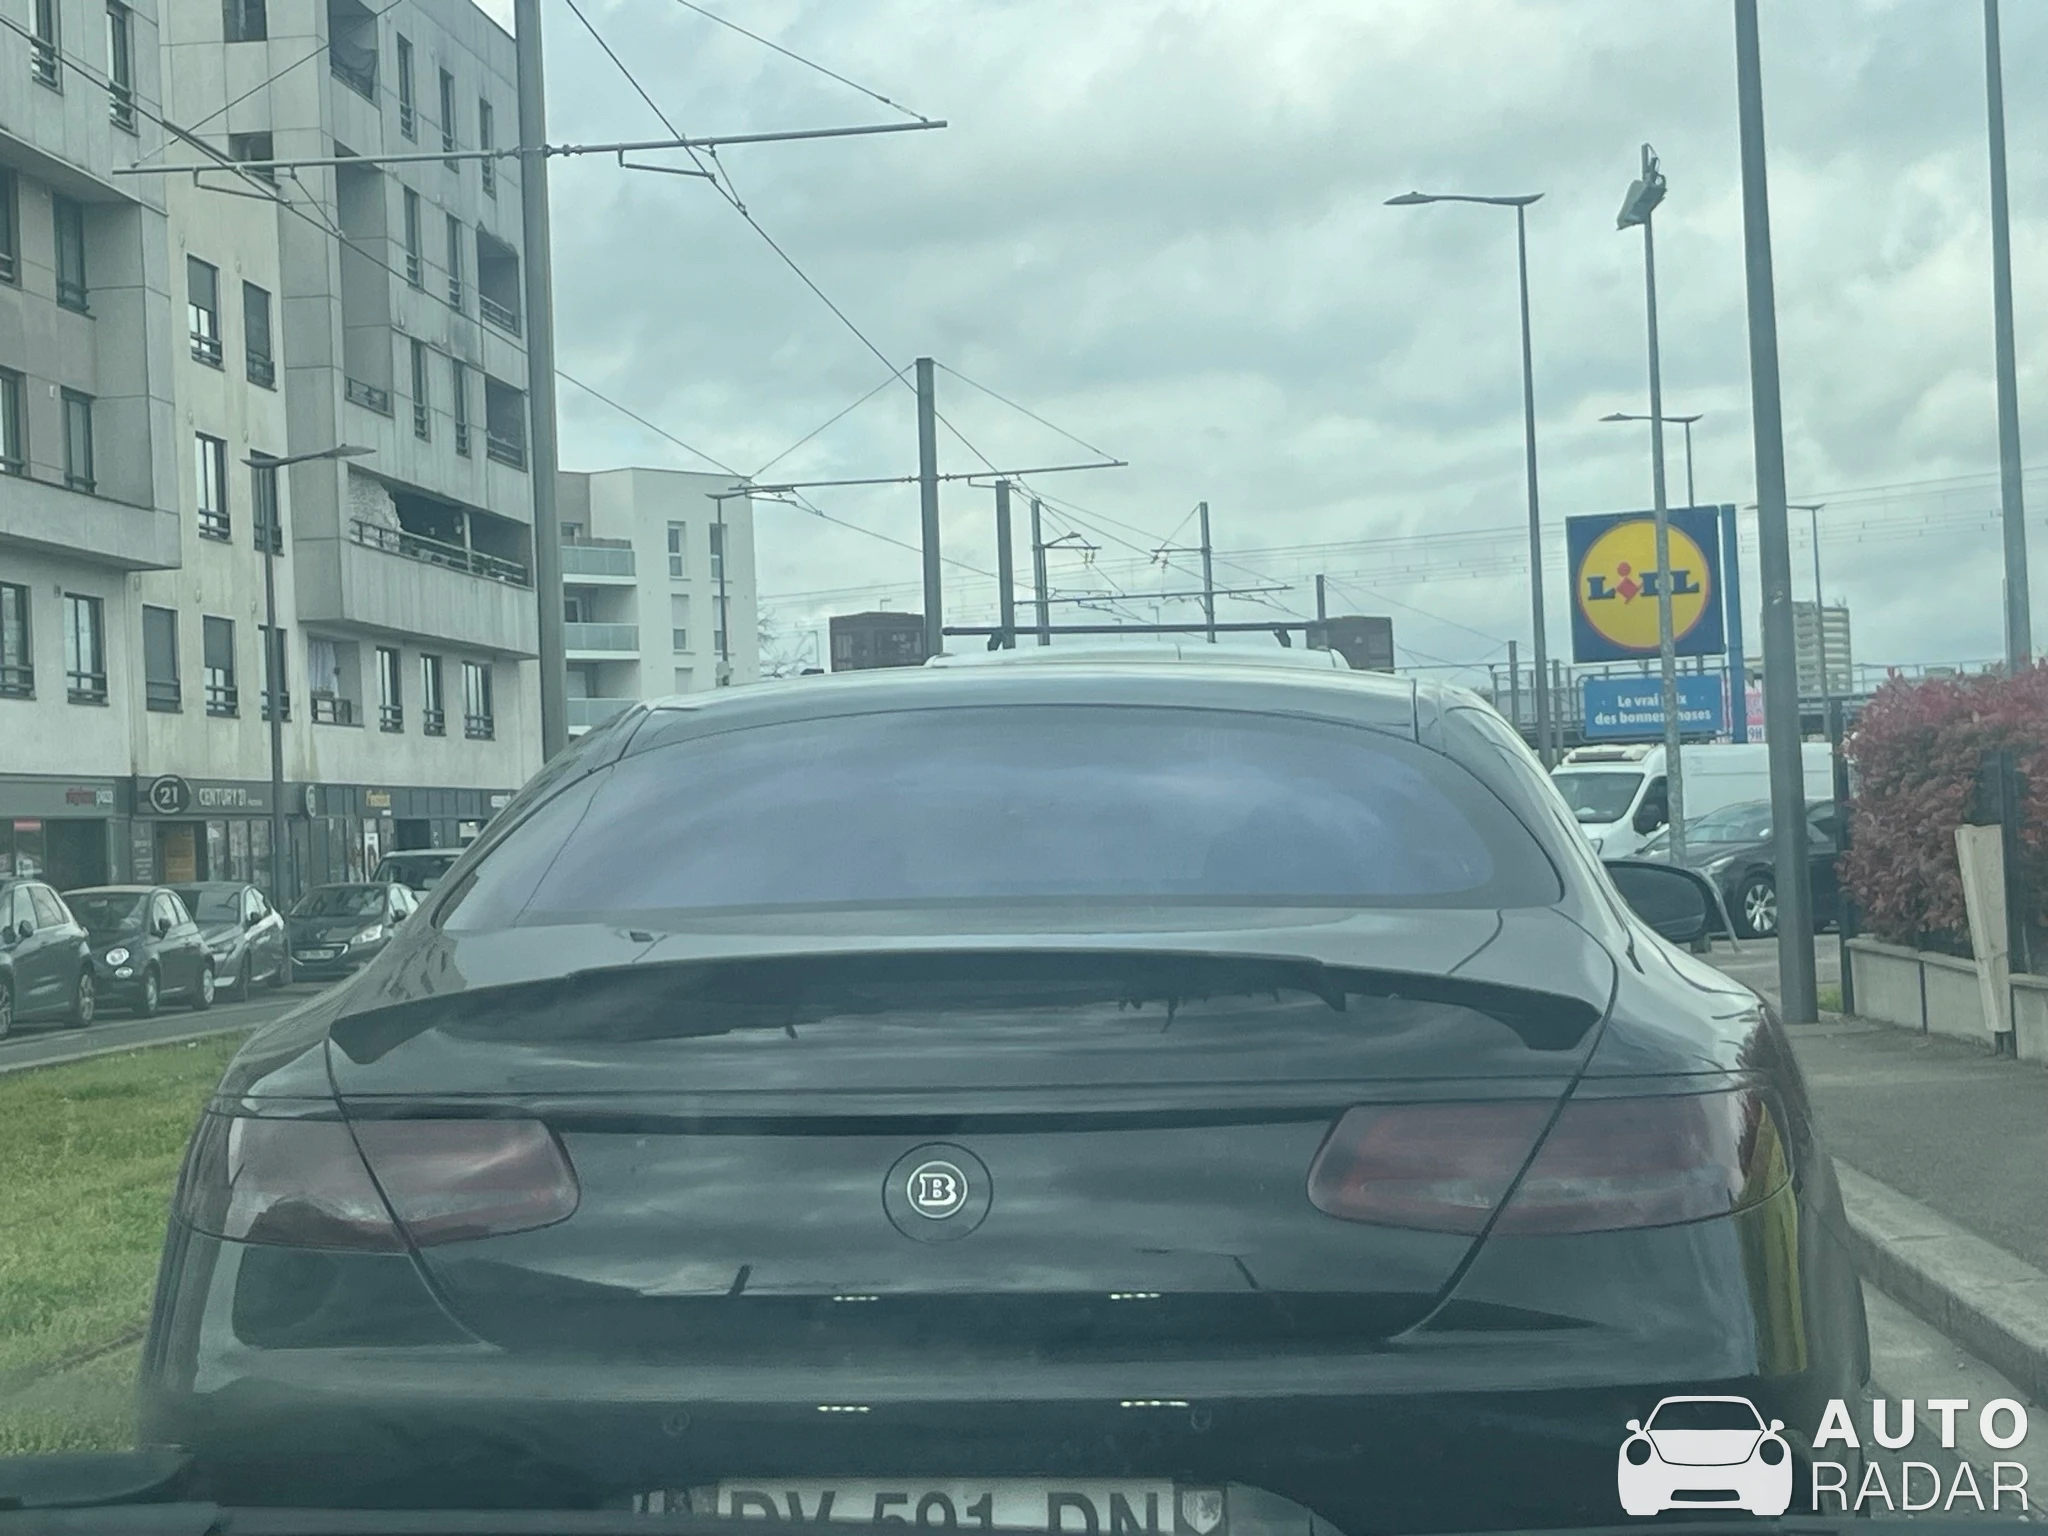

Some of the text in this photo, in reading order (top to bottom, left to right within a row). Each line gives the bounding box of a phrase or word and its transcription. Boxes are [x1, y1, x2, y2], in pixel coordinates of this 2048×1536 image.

[1617, 695, 1632, 708] Le
[1636, 693, 1659, 707] vrai
[1595, 711, 1617, 725] des
[1620, 709, 1665, 724] bonnes
[159, 786, 179, 805] 21
[199, 788, 237, 806] CENTURY
